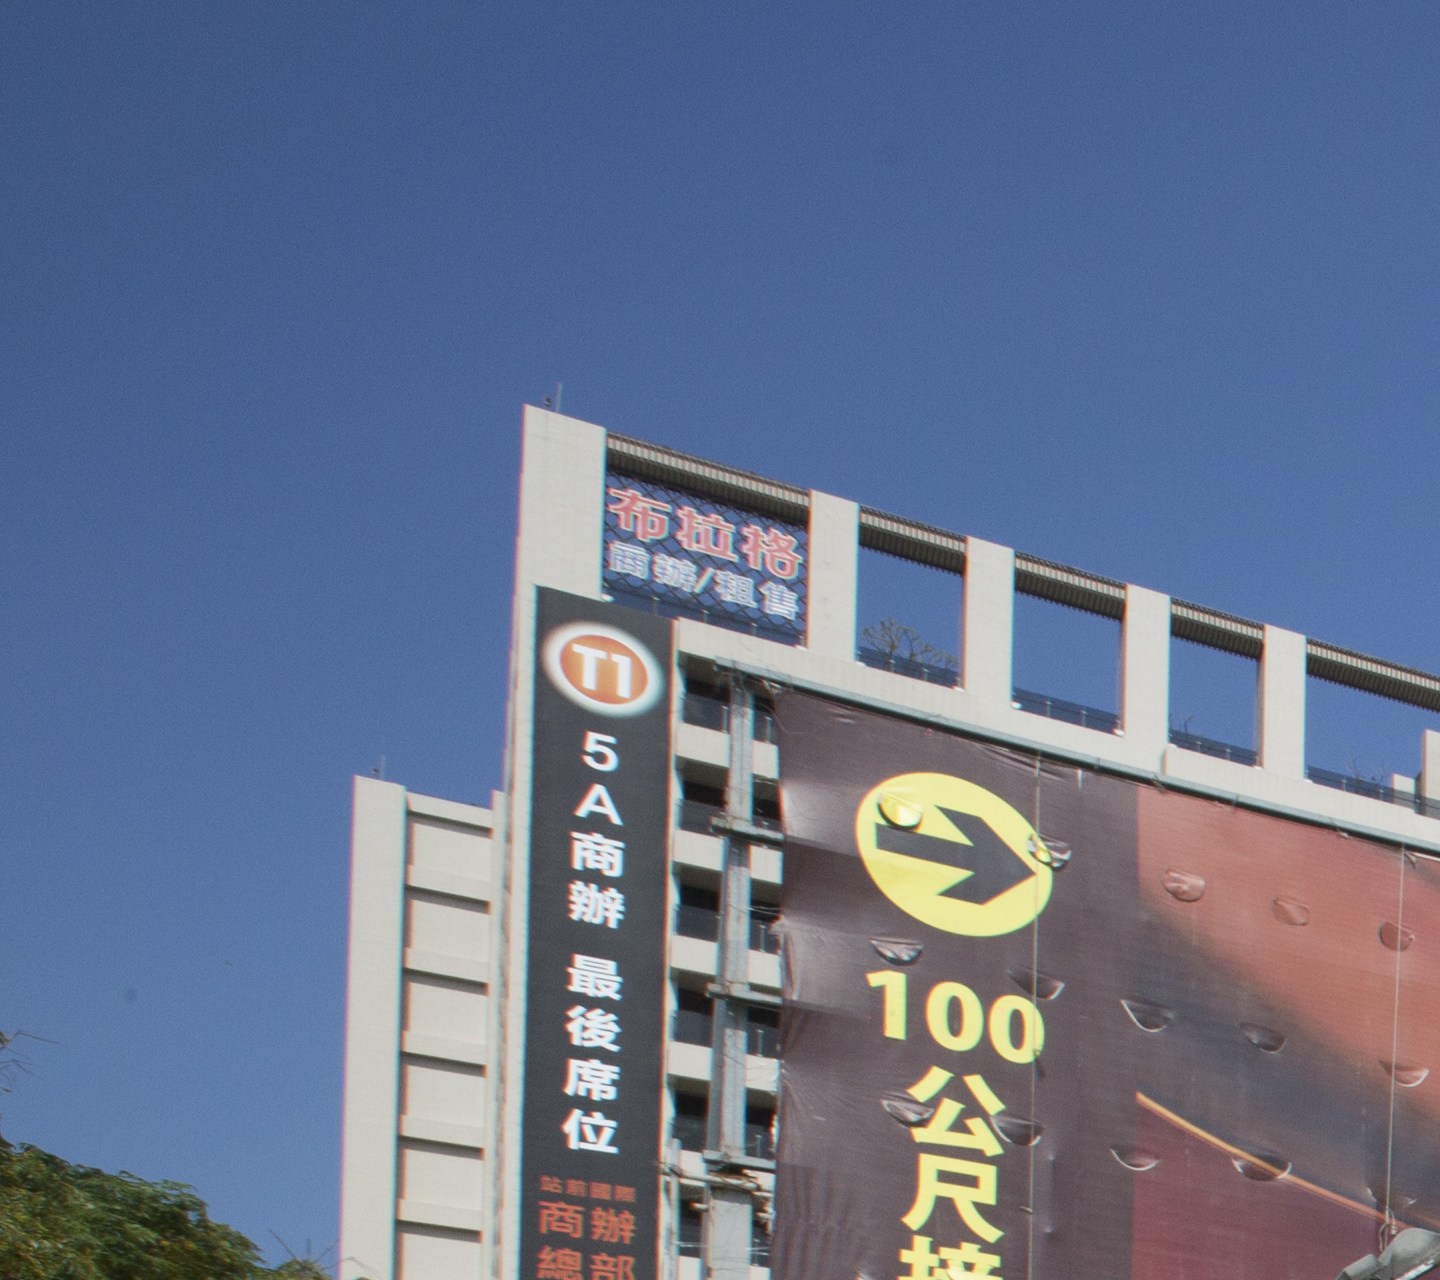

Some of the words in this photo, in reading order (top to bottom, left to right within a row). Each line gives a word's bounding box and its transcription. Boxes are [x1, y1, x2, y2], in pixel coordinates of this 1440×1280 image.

[606, 487, 803, 579] 布拉格
[570, 642, 632, 700] T1
[561, 952, 624, 1155] 最後席位
[537, 1200, 637, 1245] 商辦
